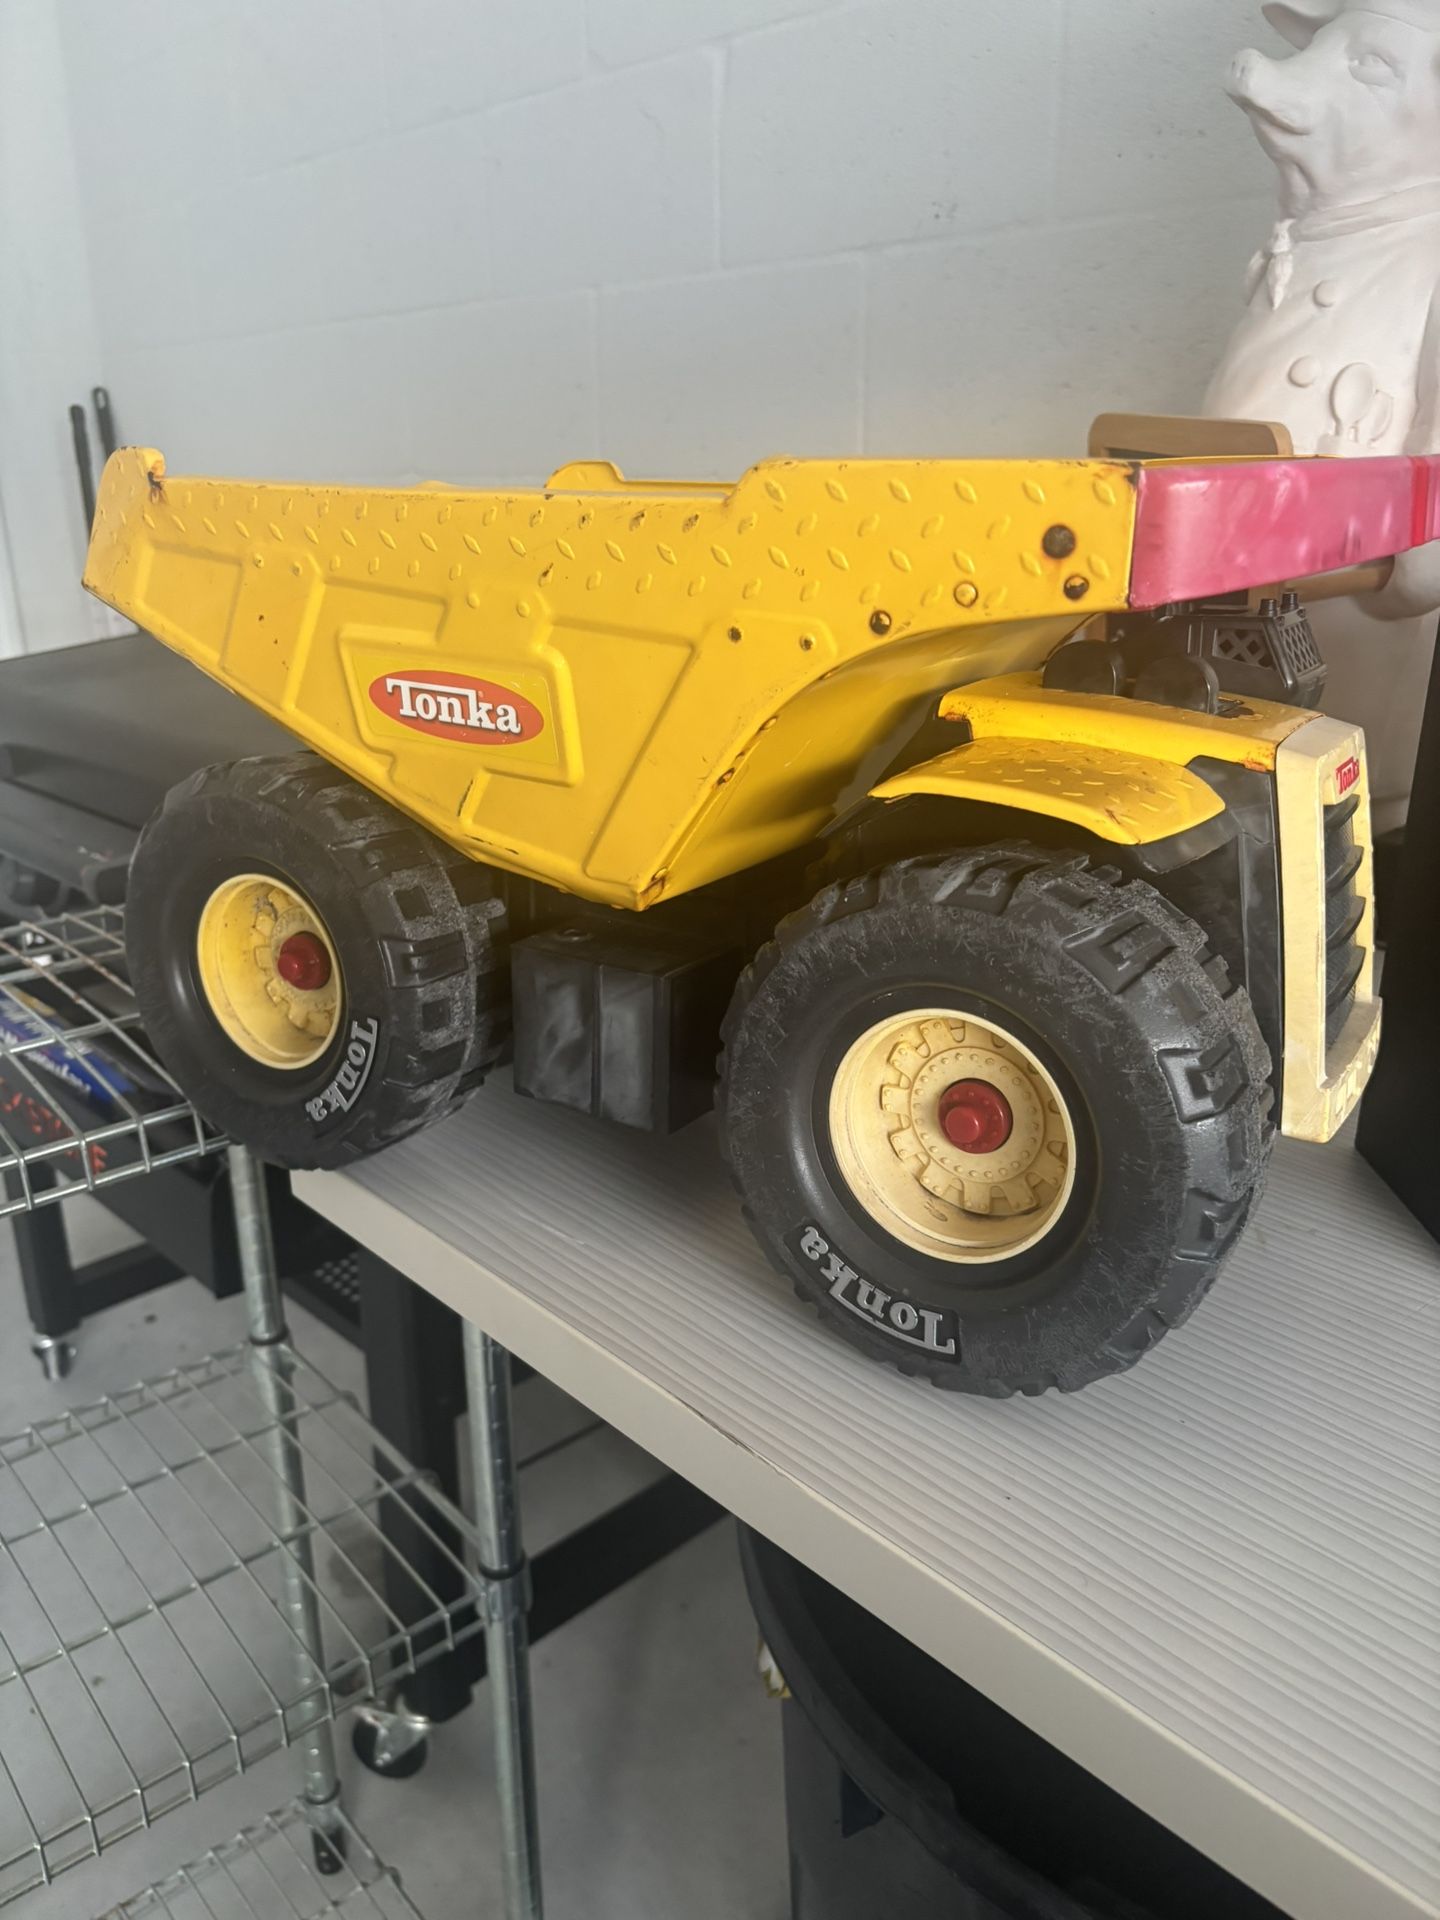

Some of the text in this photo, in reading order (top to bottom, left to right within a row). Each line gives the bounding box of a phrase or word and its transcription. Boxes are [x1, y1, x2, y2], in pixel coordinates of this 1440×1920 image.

[386, 677, 522, 734] Tonka
[305, 1017, 378, 1122] Tonka
[800, 1226, 956, 1355] Tonka
